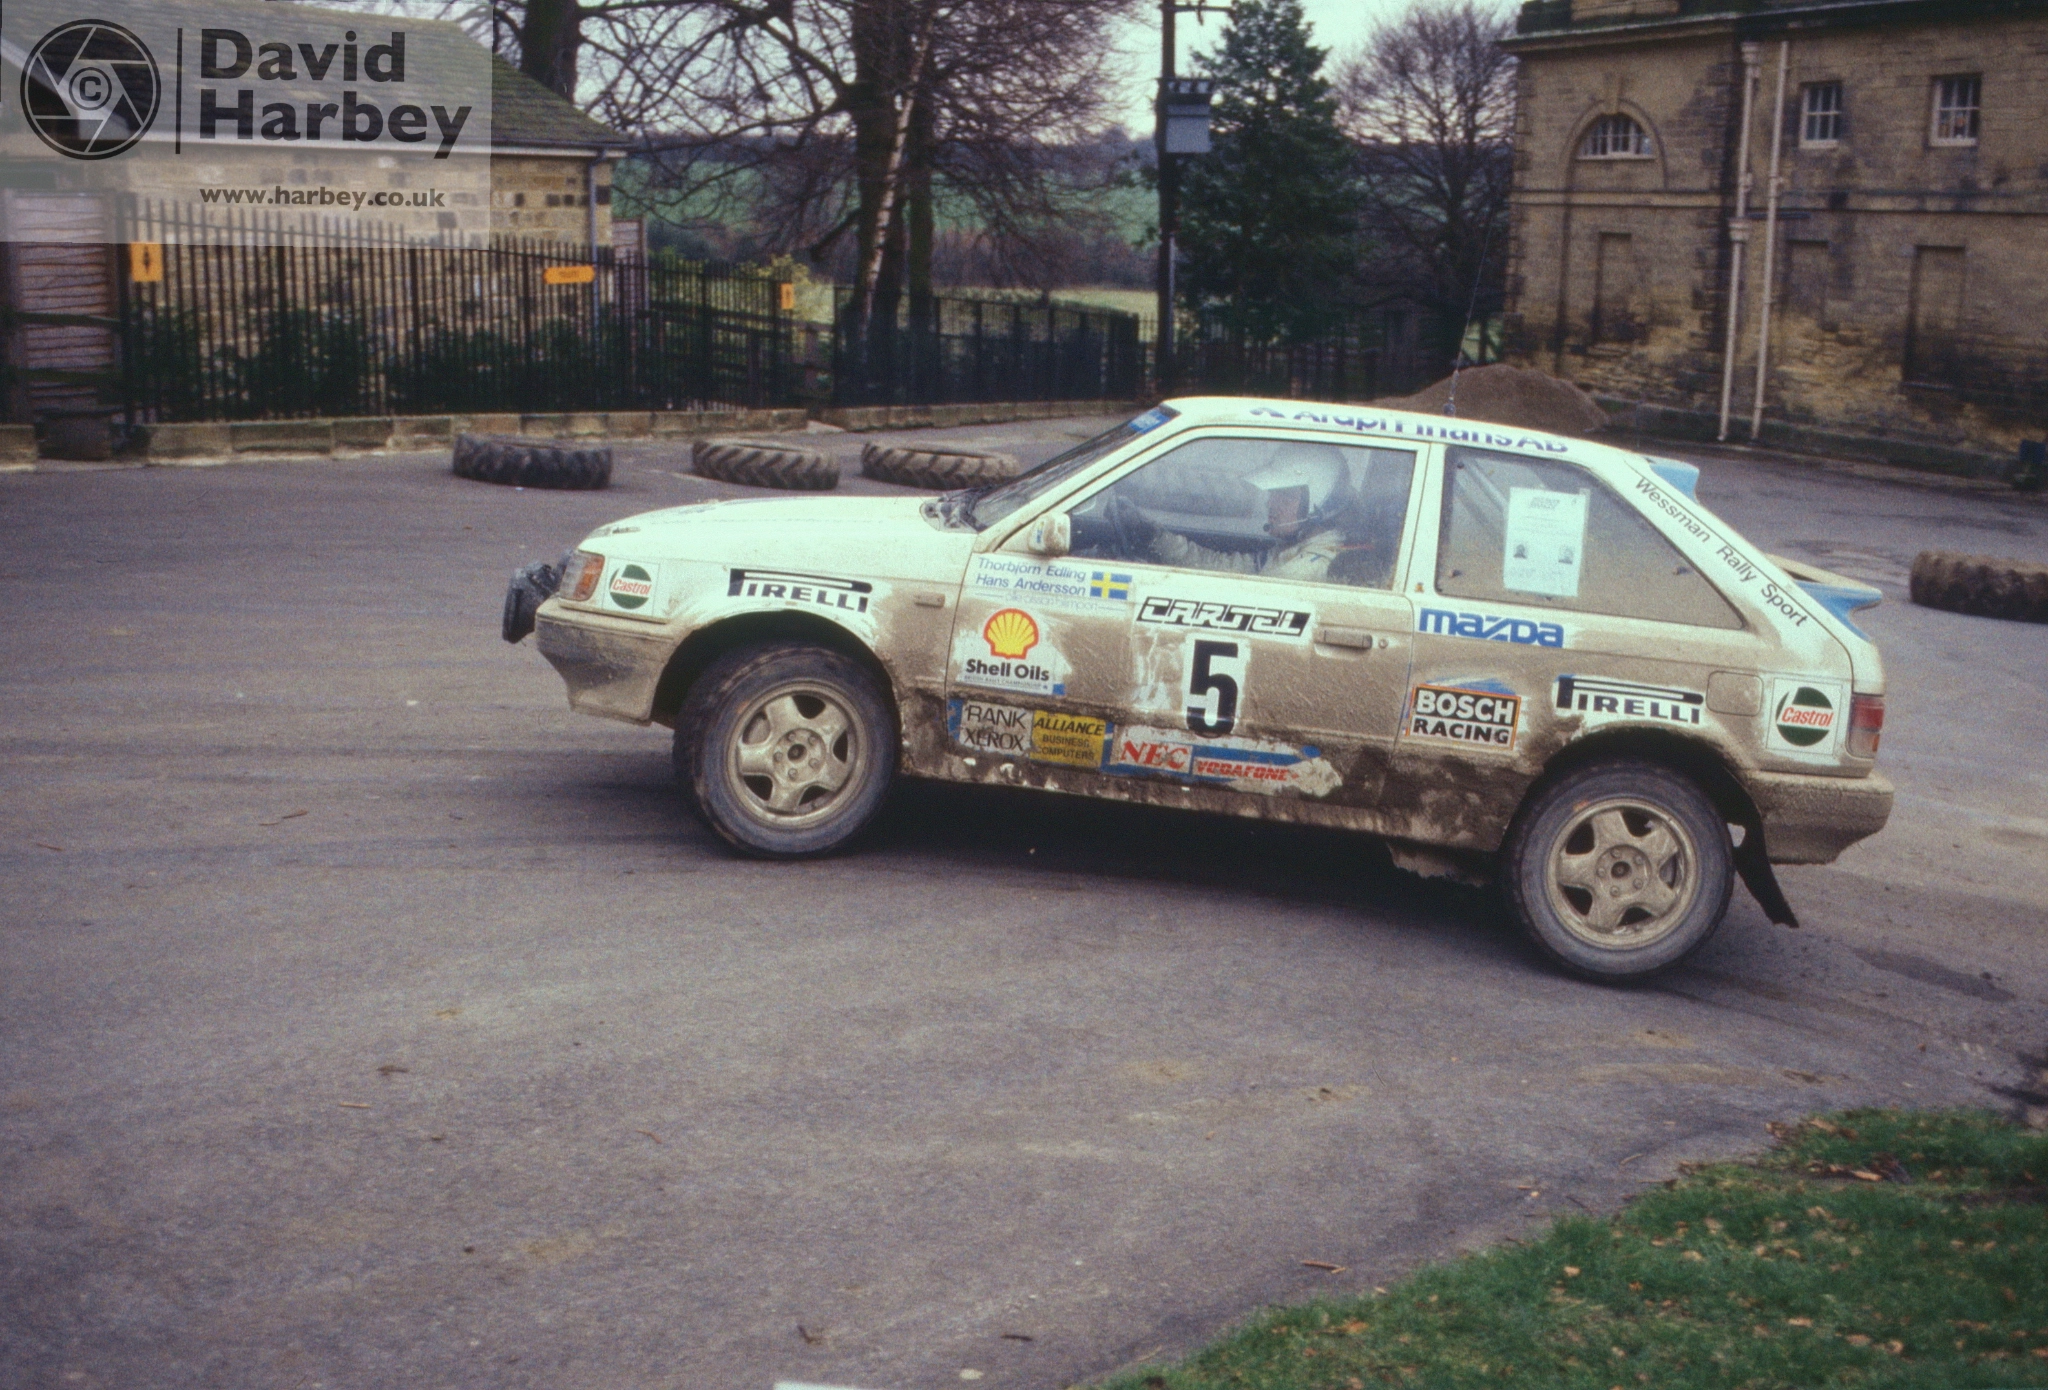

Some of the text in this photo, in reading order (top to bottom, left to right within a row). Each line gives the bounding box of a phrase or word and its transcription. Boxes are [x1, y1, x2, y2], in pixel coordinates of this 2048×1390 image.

[1635, 476, 1809, 627] Wessman Rally Sport
[975, 573, 1087, 596] Hans Andersson
[1045, 565, 1087, 582] Edling
[612, 579, 651, 596] Castrol
[727, 568, 872, 613] PIRELLI
[1137, 596, 1311, 637] CARTEL
[966, 658, 1050, 682] Shell Oils
[1186, 639, 1239, 738] 5
[1556, 677, 1704, 724] PIRELLI
[967, 705, 1027, 730] RANK
[1416, 690, 1514, 724] BOSCH
[1781, 706, 1834, 727] Castrol
[1034, 717, 1105, 736] ALLIANCE
[1413, 718, 1510, 744] RACING
[964, 728, 1025, 751] XEROX
[1120, 740, 1189, 770] NEC
[1197, 761, 1289, 781] VODAFONE
